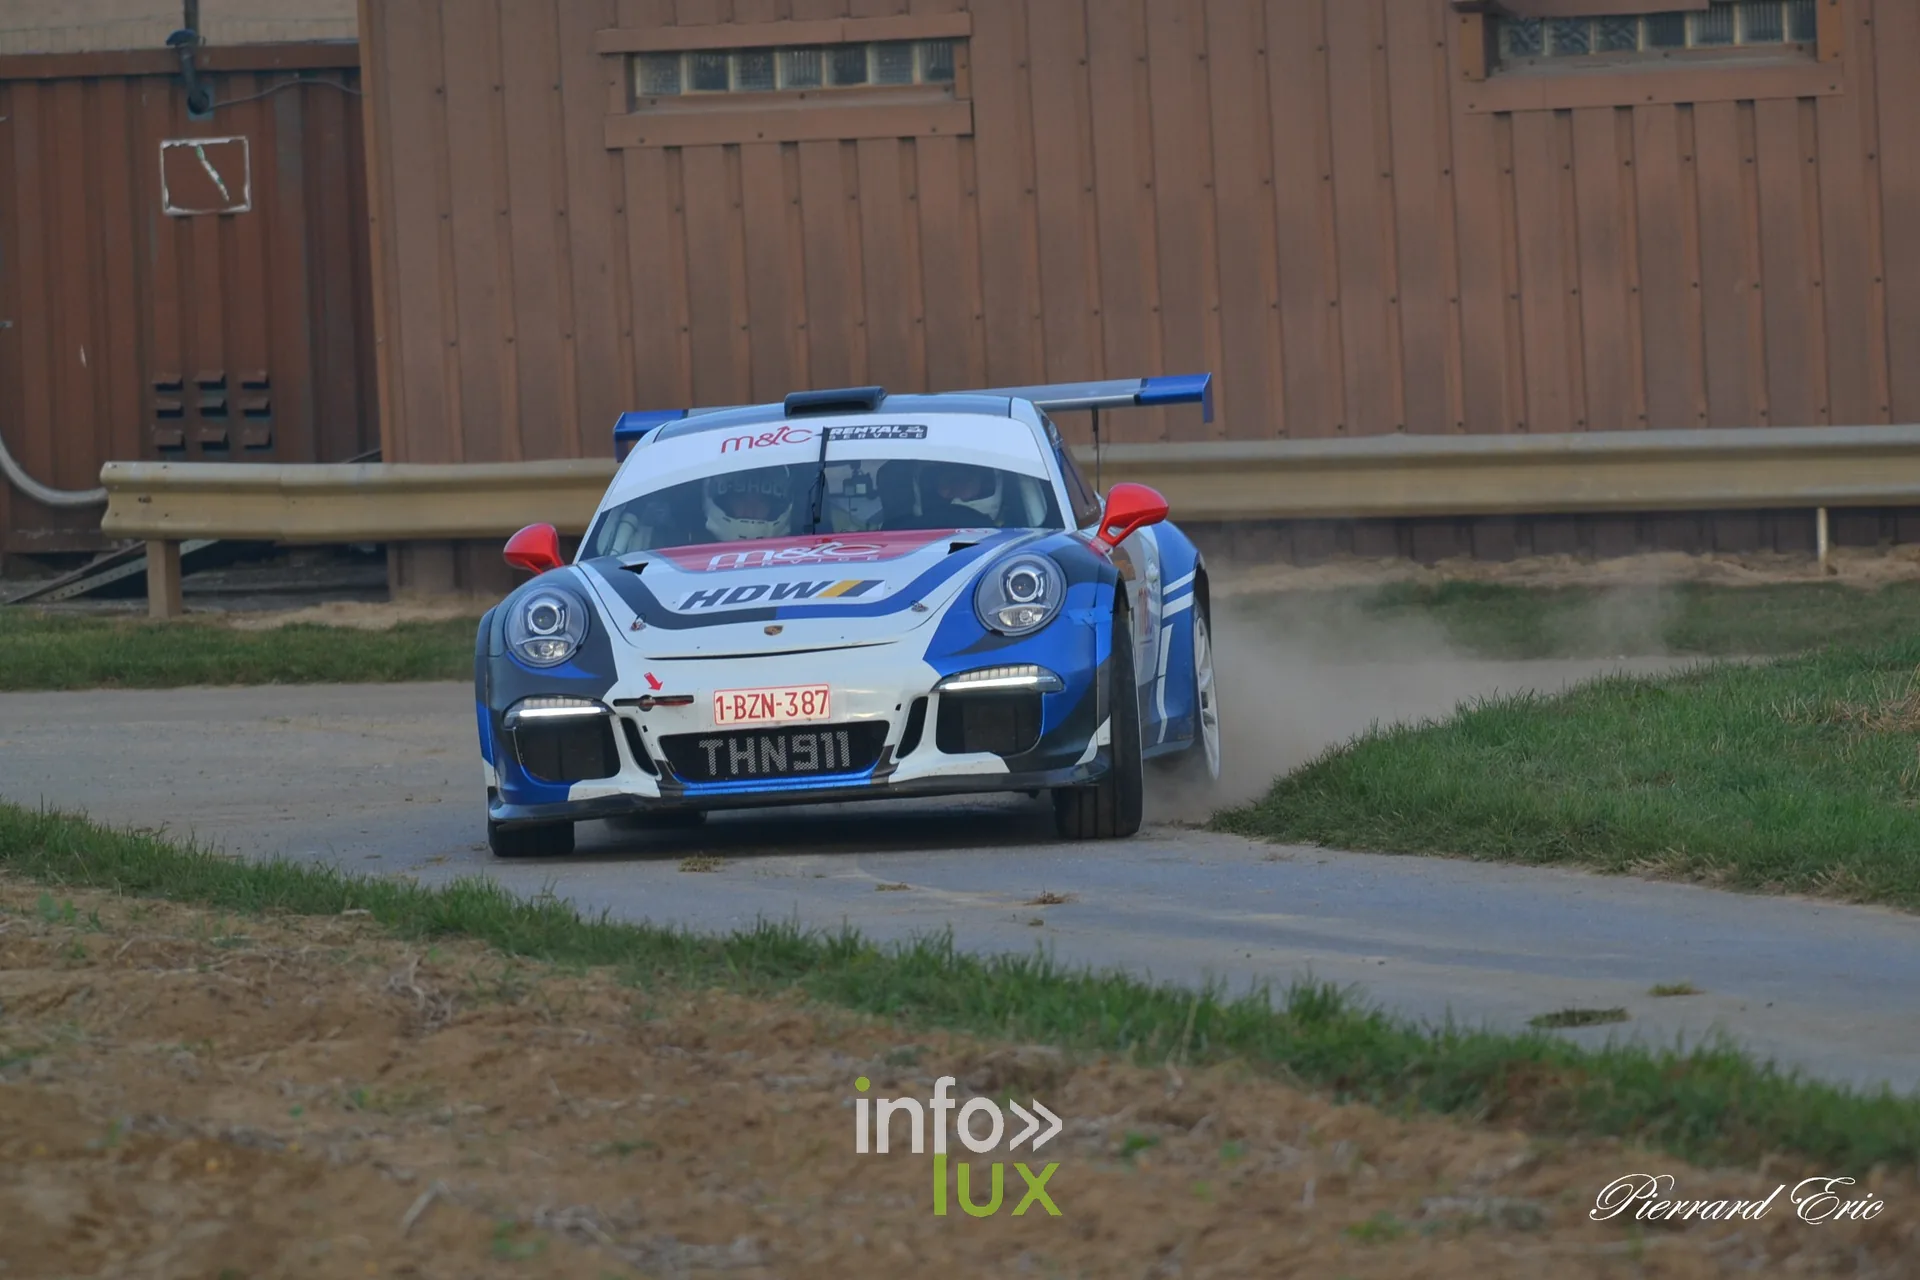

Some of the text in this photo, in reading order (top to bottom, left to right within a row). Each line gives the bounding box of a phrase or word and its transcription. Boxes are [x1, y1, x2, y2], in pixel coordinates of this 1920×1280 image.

[829, 426, 901, 436] RENTAL
[829, 432, 923, 440] SERVICE
[678, 580, 835, 610] HDW
[715, 690, 828, 720] 1-BZN-387
[699, 730, 850, 776] THN911
